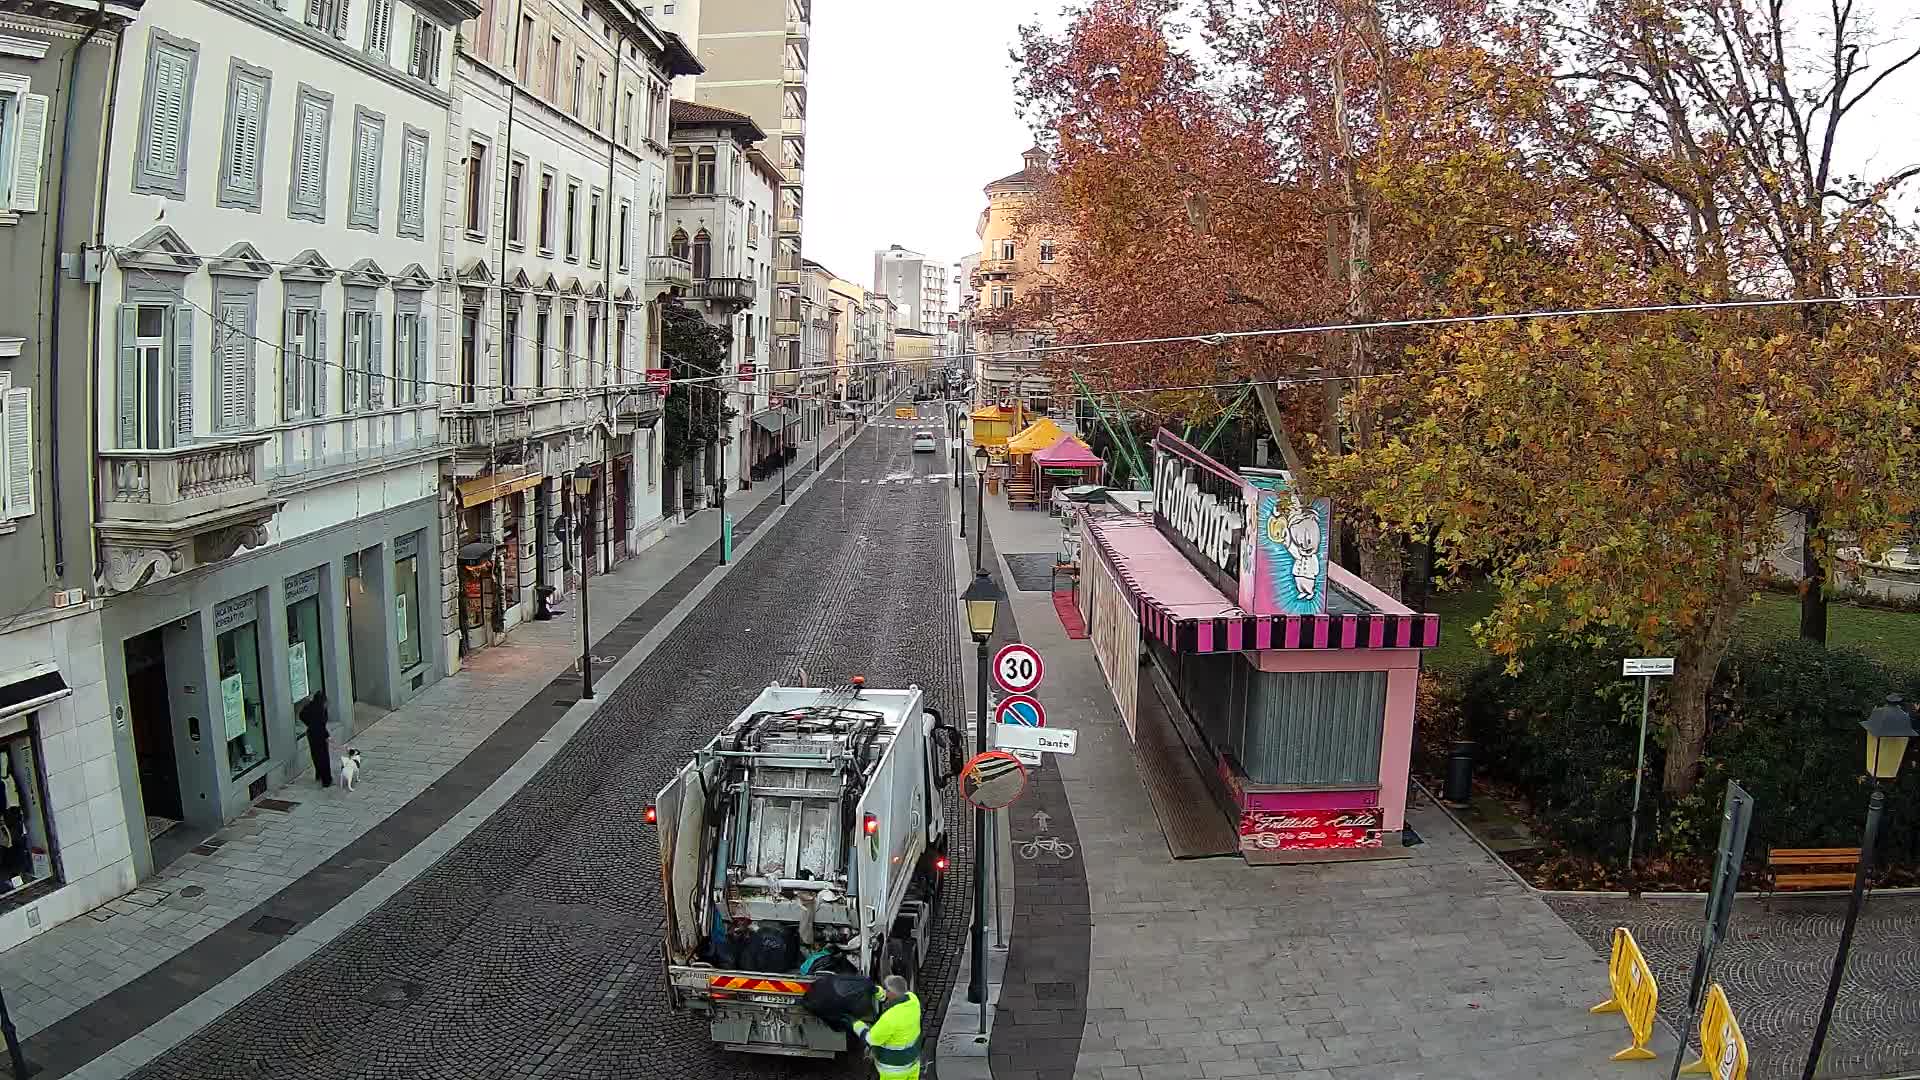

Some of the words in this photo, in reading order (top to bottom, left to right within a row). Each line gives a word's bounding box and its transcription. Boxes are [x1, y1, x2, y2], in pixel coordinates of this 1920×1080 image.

[1162, 458, 1242, 570] Golosone
[1005, 658, 1033, 680] 30
[1038, 737, 1070, 748] Dante
